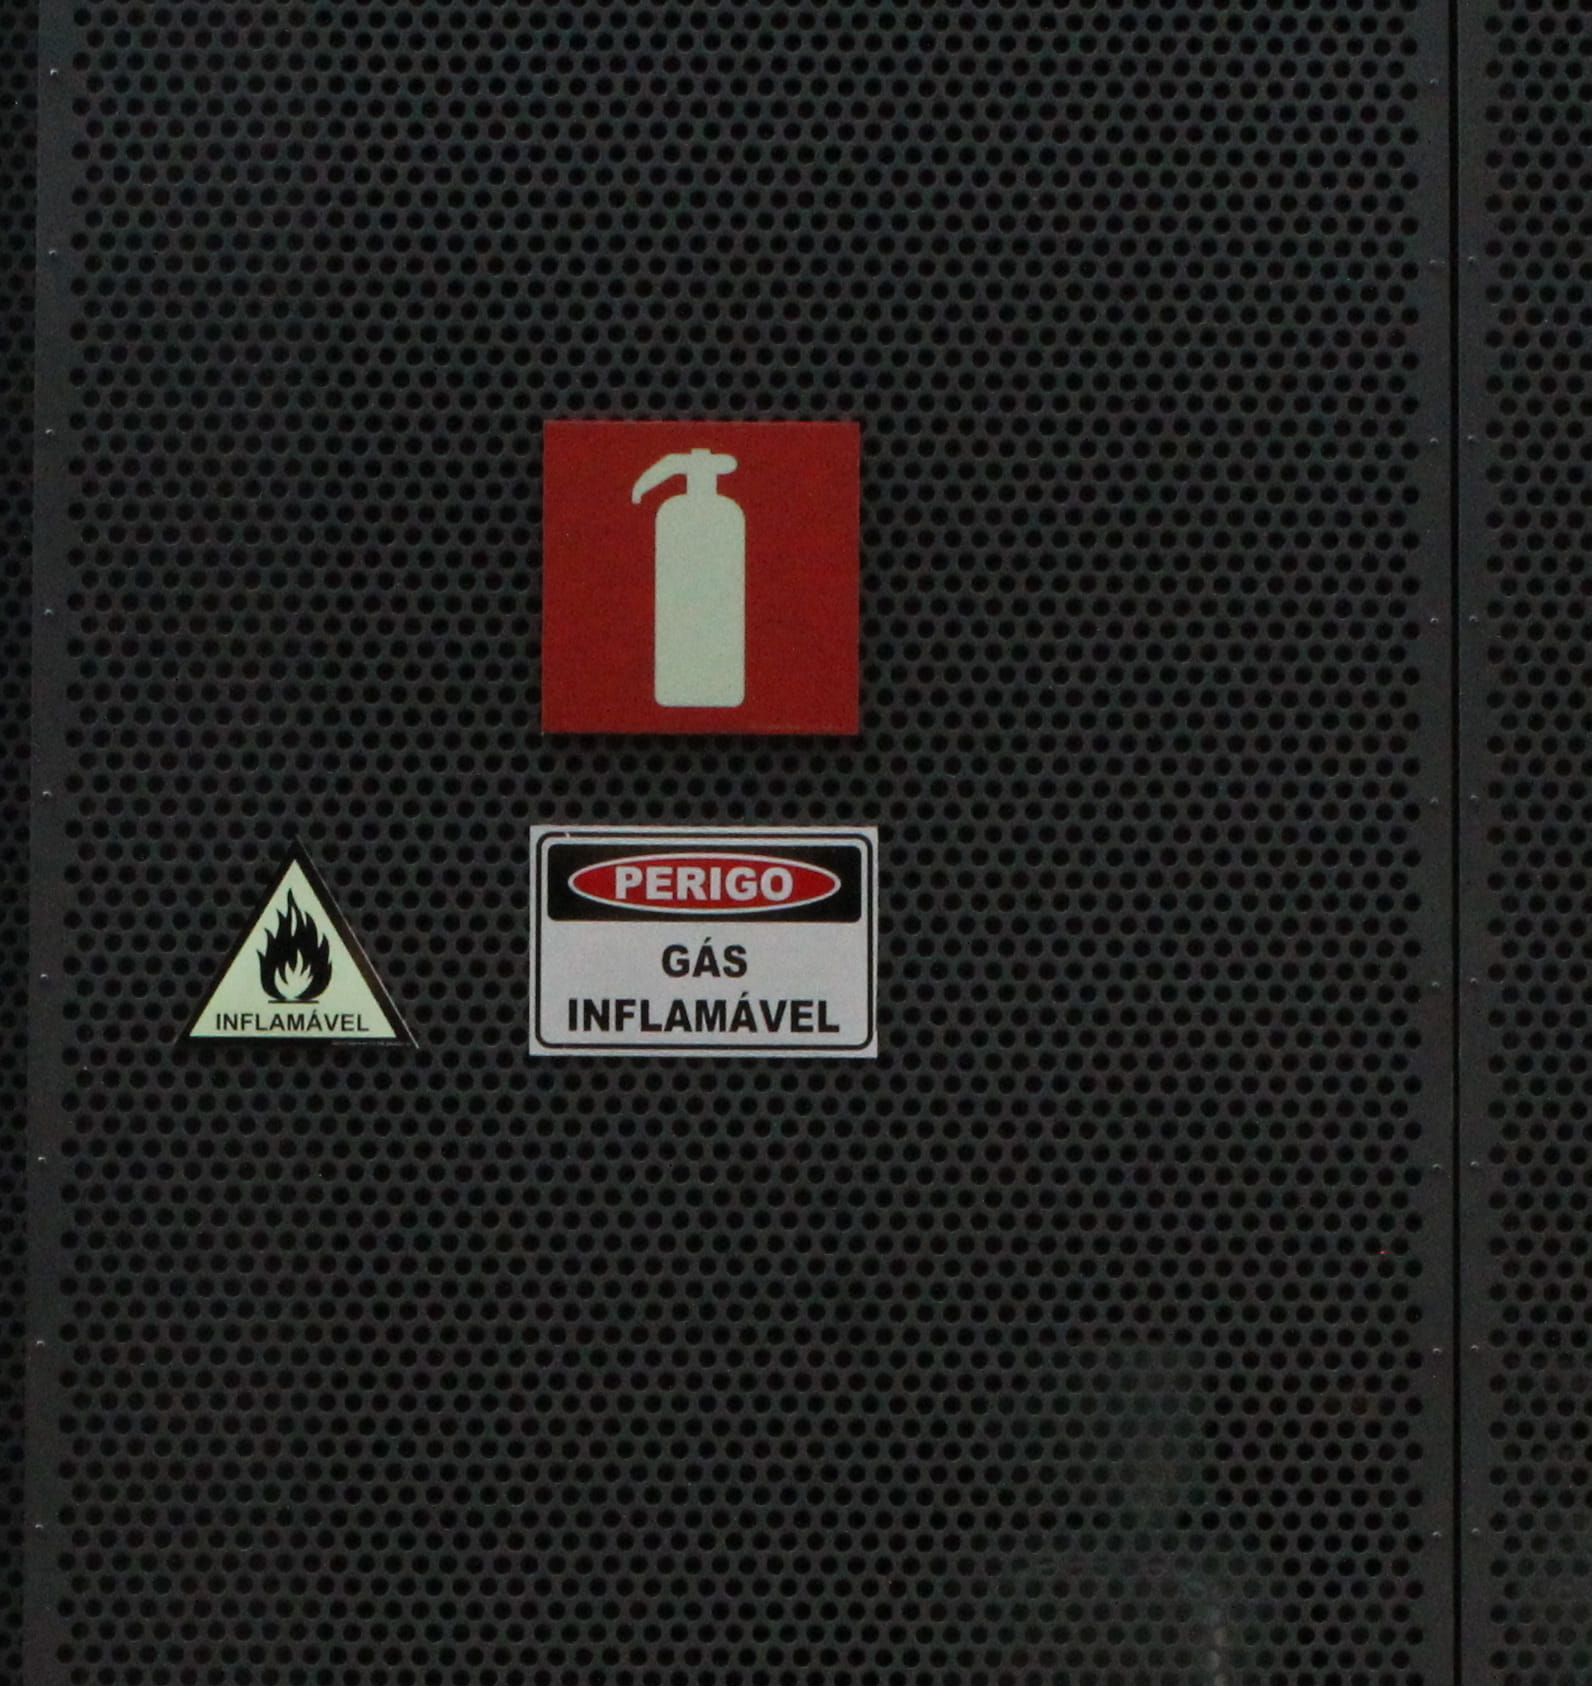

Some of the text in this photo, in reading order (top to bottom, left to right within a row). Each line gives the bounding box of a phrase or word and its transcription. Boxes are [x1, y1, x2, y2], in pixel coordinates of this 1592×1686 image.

[614, 866, 795, 902] PERIGO
[661, 938, 749, 979] GÁS
[215, 1009, 370, 1033] INFLAMÁVEL
[567, 992, 841, 1033] INFLAMÁVEL
